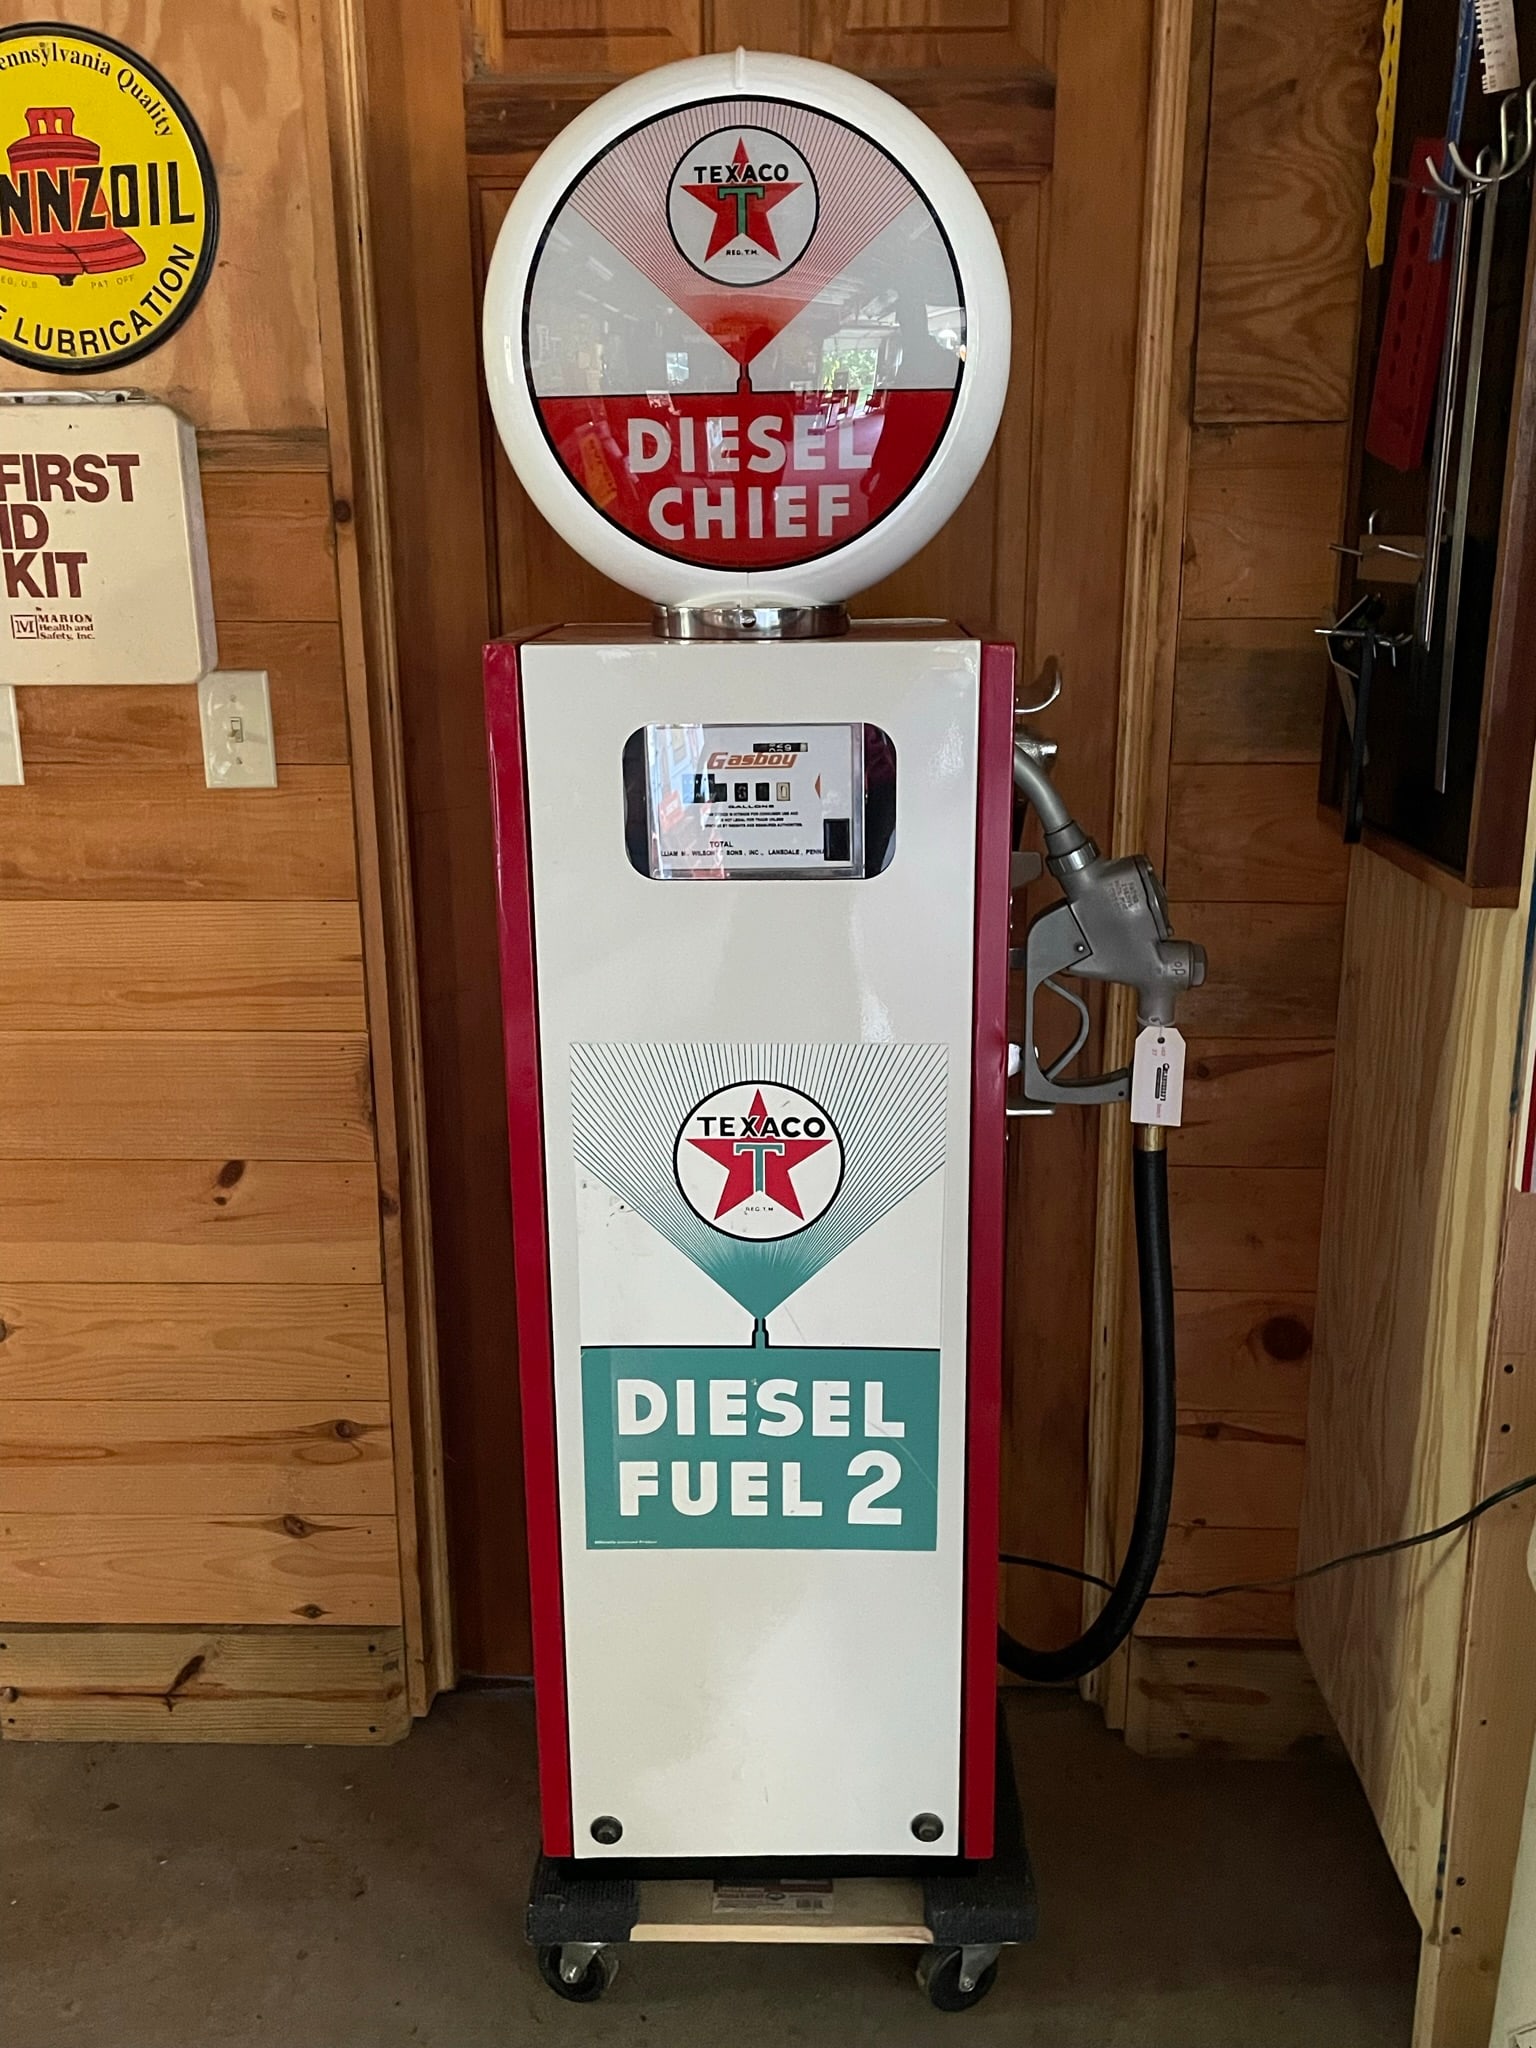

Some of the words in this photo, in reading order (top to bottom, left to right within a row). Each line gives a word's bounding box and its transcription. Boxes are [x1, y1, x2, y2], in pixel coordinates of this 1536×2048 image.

[116, 68, 173, 138] Quality
[694, 164, 789, 184] TEXACO
[14, 243, 196, 355] LUBRICATION
[627, 415, 873, 474] DIESEL
[0, 454, 141, 503] FIRST
[648, 484, 850, 541] CHIEF
[2, 552, 88, 598] KIT
[38, 614, 93, 623] MARION
[39, 624, 73, 632] Health
[74, 624, 94, 632] and
[76, 632, 96, 640] Inc.
[707, 751, 798, 770] Gasboy
[697, 1117, 826, 1138] TEXACO
[617, 1378, 906, 1438] DIESEL
[619, 1461, 823, 1517] FUEL
[847, 1450, 903, 1526] 2
